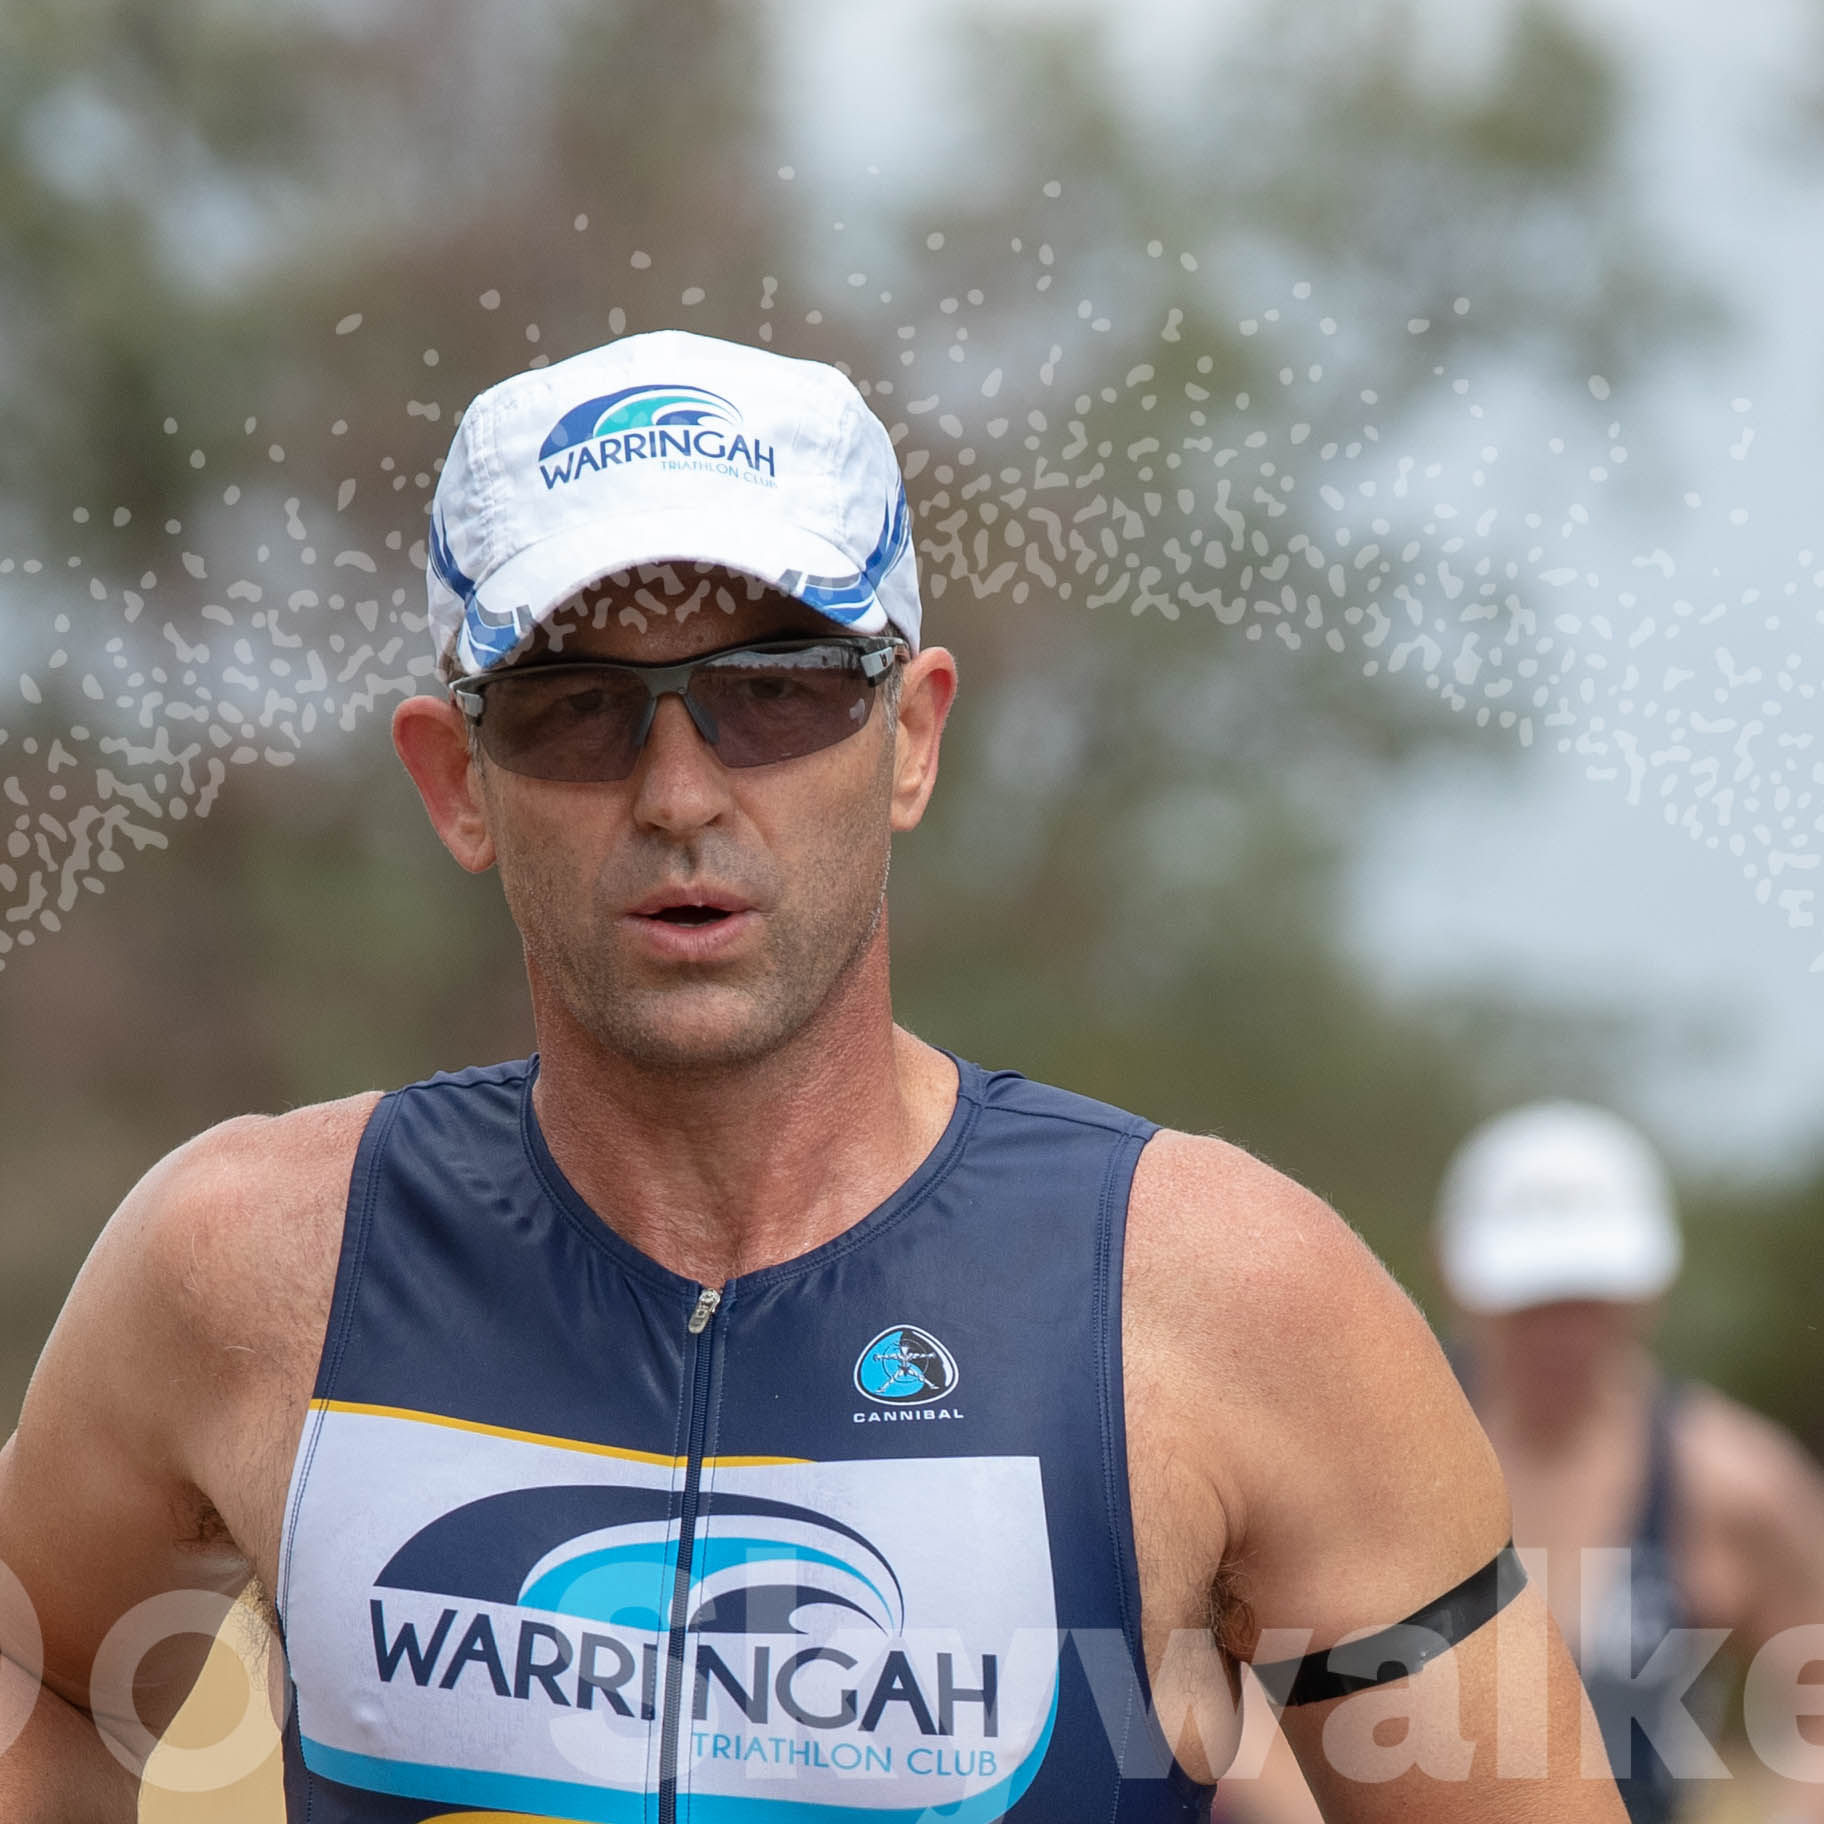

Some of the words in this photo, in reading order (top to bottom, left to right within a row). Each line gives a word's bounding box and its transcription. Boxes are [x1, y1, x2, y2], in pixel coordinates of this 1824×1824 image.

[539, 430, 775, 490] WARRINGAH
[660, 460, 739, 478] TRIATHLON
[853, 1408, 964, 1423] CANNIBAL
[369, 1599, 998, 1738] WARRINGAH
[693, 1732, 892, 1773] TRIATHLON
[907, 1747, 997, 1777] CLUB
